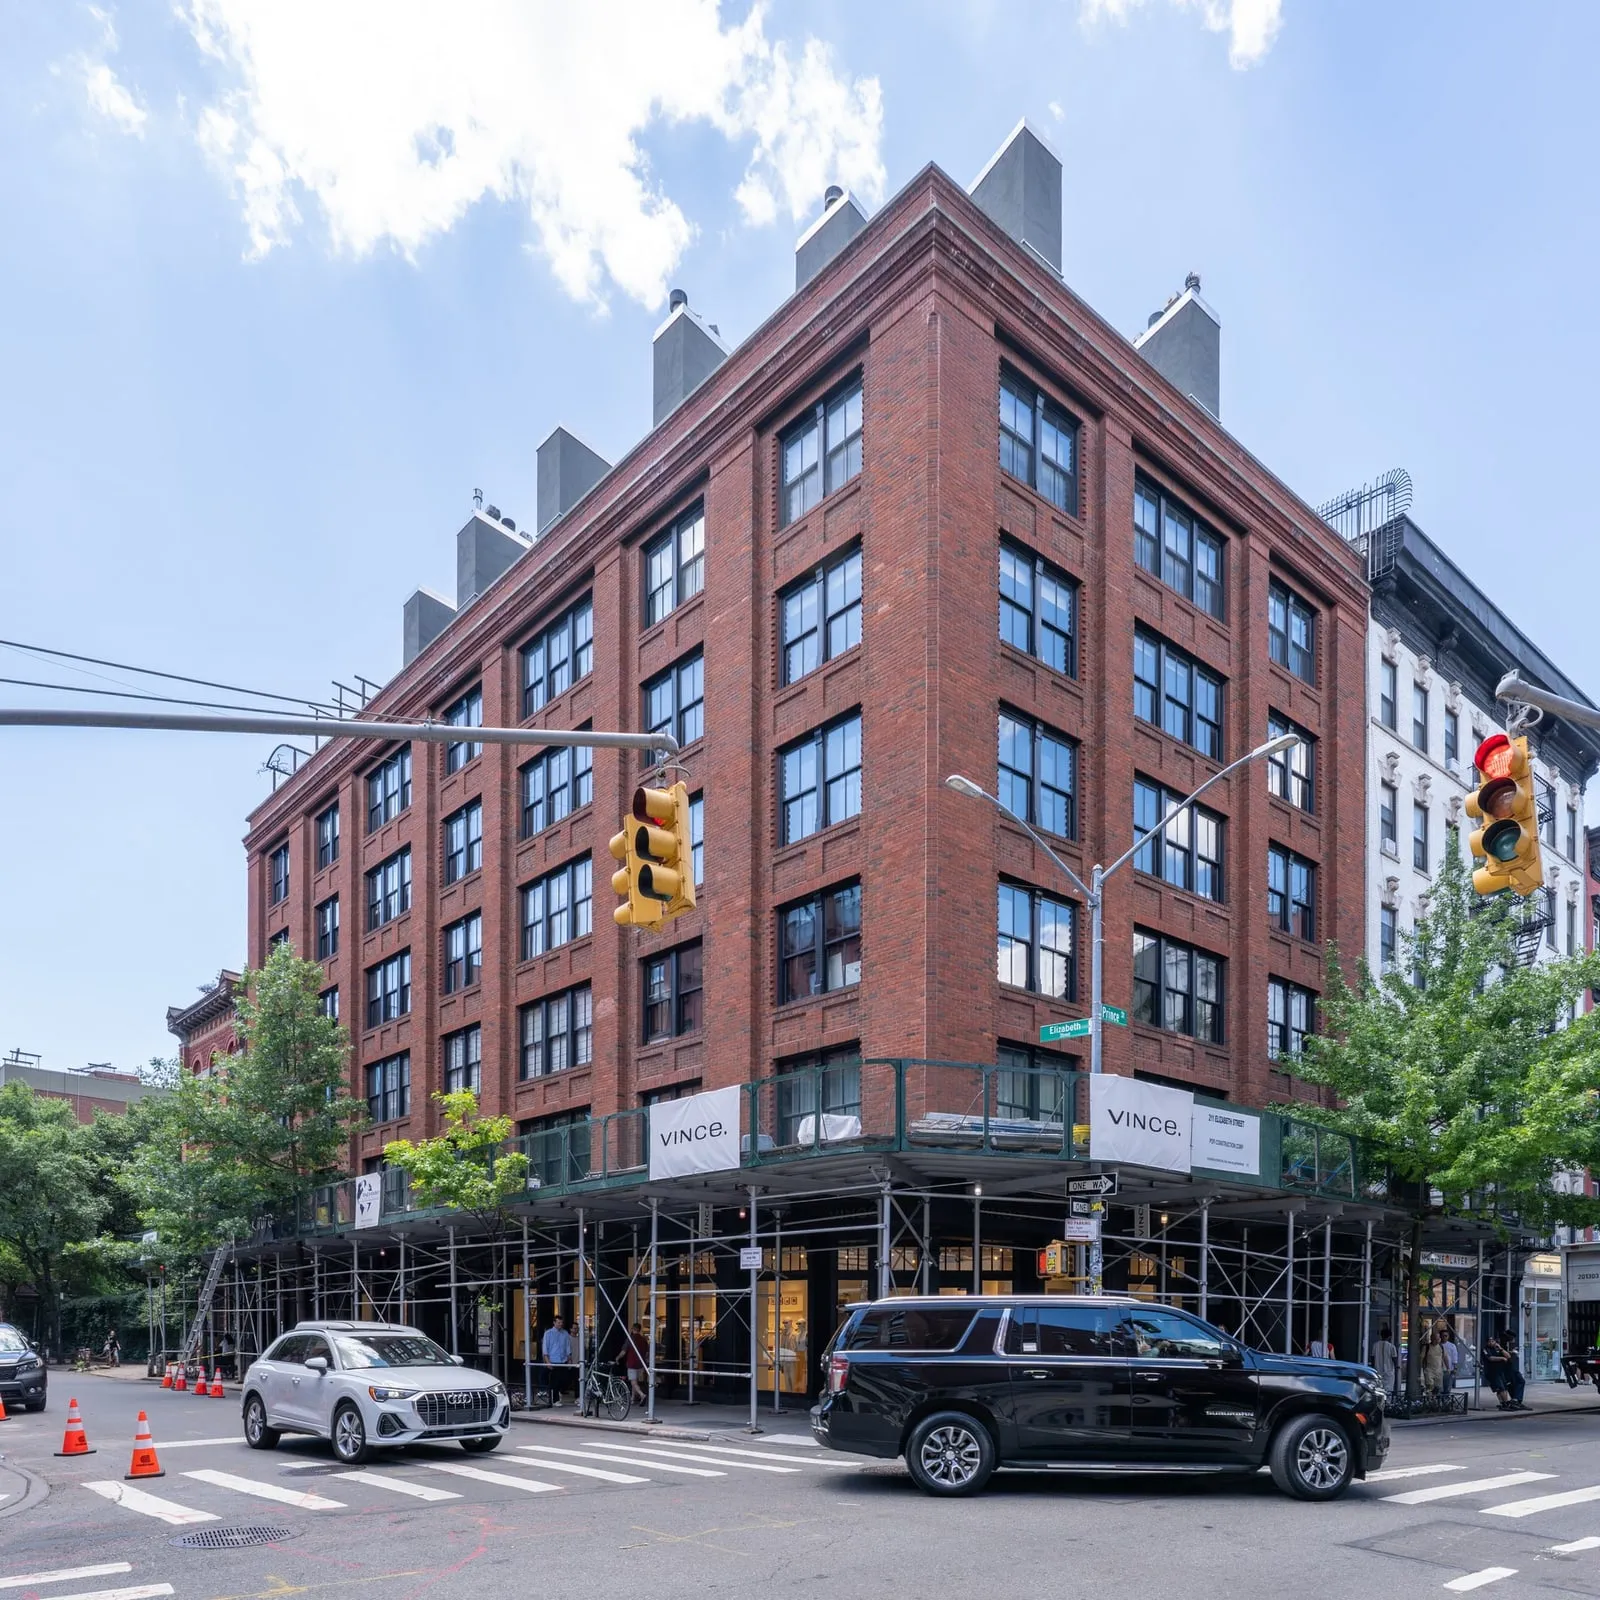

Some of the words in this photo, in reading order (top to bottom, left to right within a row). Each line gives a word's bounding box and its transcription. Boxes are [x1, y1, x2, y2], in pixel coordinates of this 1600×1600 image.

[1102, 1006, 1120, 1023] Prince
[1049, 1022, 1081, 1034] Elizabeth
[1072, 1181, 1087, 1190] ONE
[1092, 1180, 1109, 1189] WAY
[1075, 1203, 1088, 1212] ONE
[1450, 1256, 1468, 1265] LAYER
